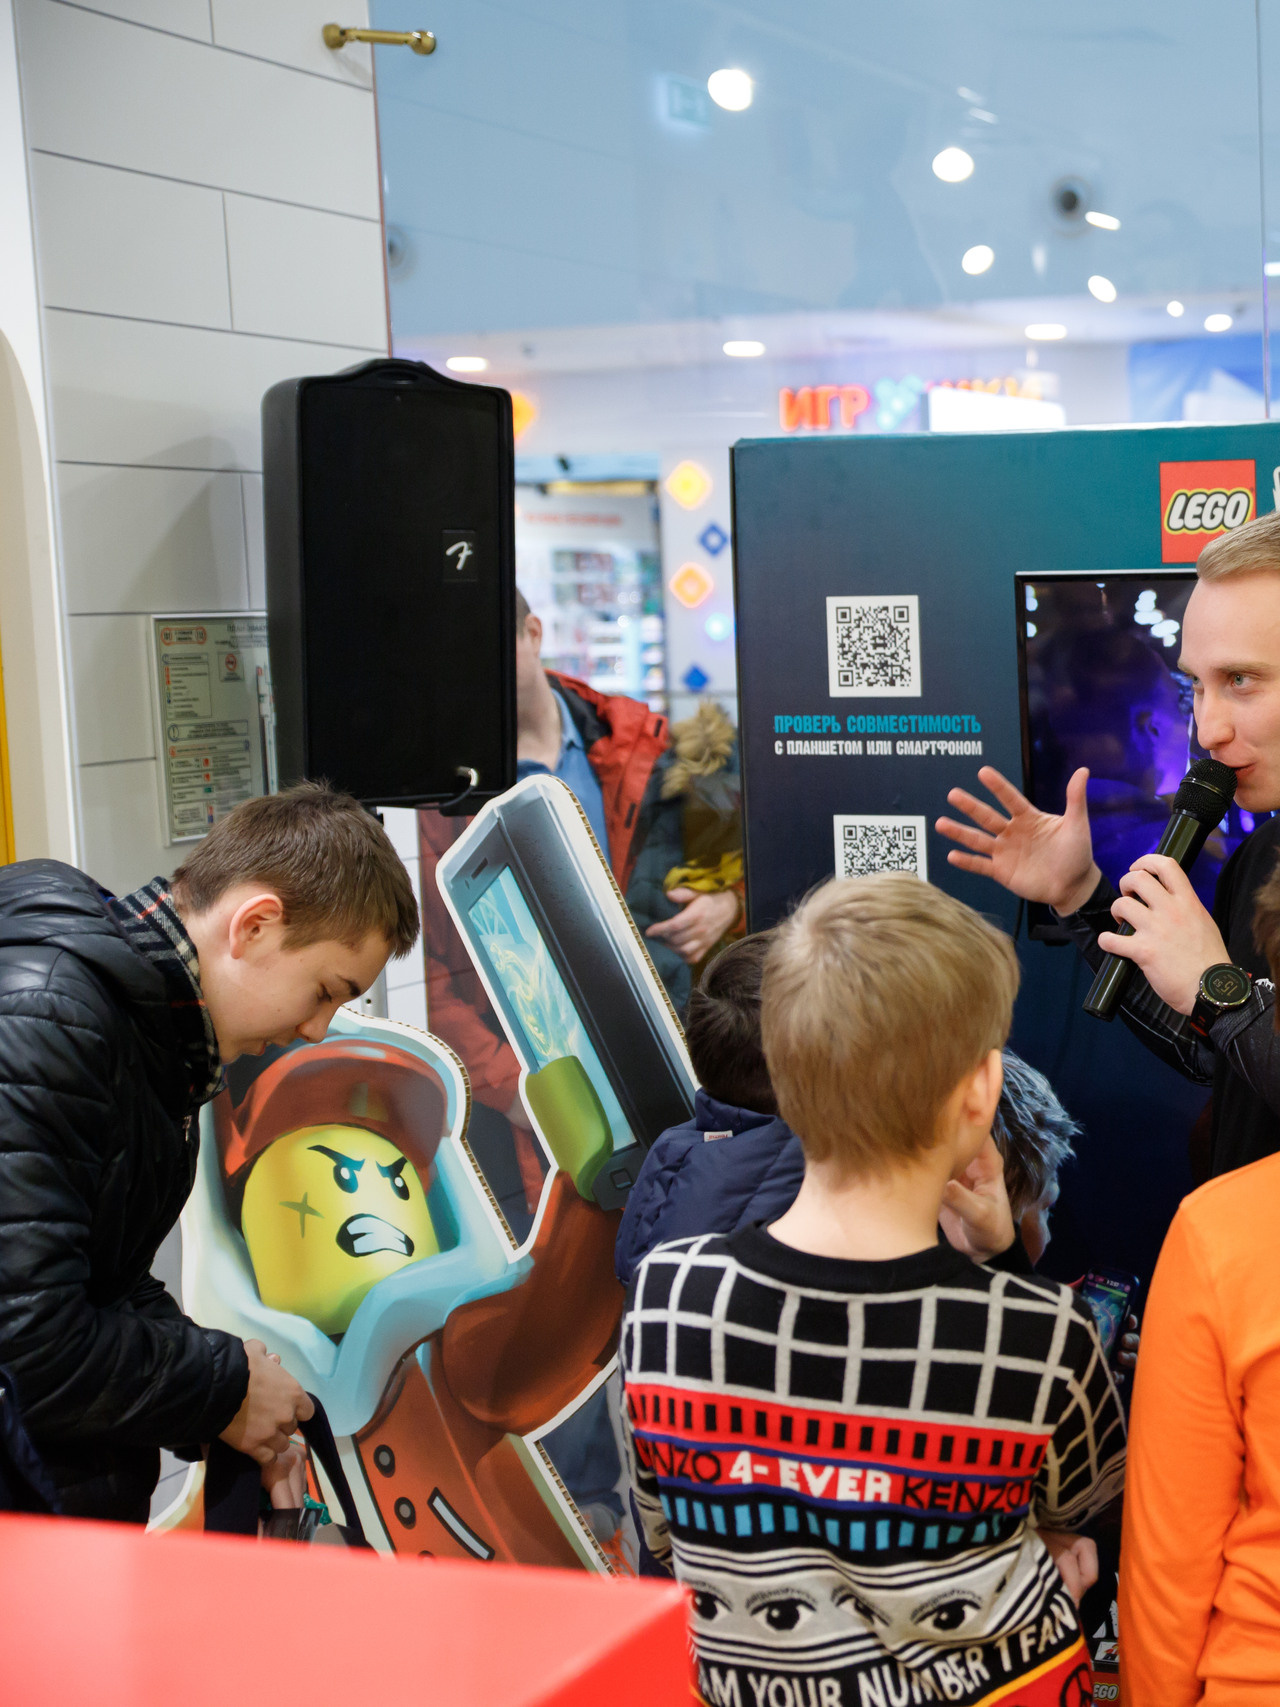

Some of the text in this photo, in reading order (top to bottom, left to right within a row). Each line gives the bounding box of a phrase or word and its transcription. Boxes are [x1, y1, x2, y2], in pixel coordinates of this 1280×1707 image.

[1168, 490, 1251, 533] LEGO
[774, 714, 981, 734] ПРОВЕРЬ СОВМЕСТИМОСТЬ
[774, 740, 983, 756] С ПЛАНШЕТОМ ИЛИ СМАРТФОНОМ
[901, 1480, 1025, 1514] KENZO
[747, 1671, 842, 1707] YOUR
[857, 1645, 990, 1707] NUMBER
[1018, 1592, 1079, 1663] FAN
[1094, 1684, 1118, 1700] EGO
